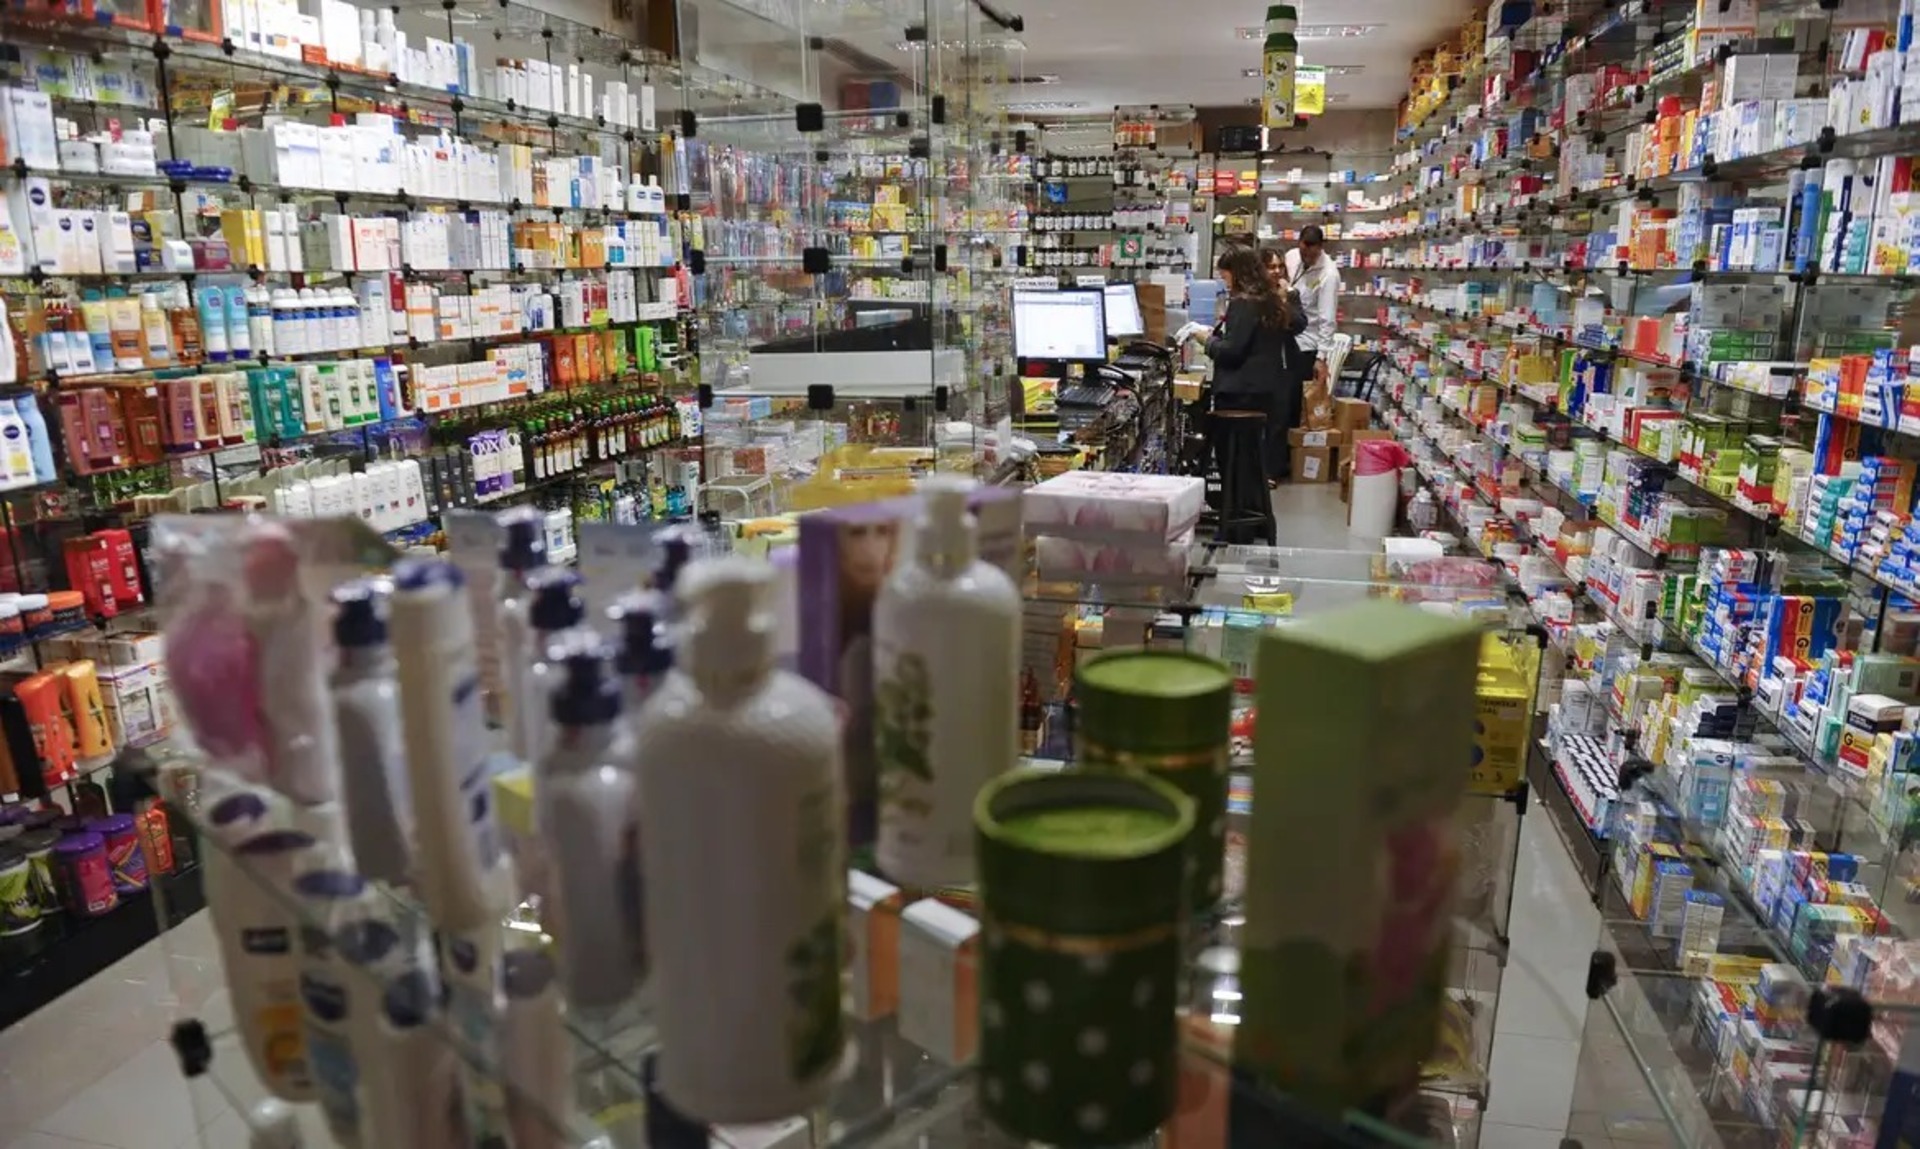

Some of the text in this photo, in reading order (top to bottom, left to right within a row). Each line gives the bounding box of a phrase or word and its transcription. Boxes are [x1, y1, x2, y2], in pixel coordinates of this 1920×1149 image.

[1801, 603, 1813, 614] G
[1797, 637, 1809, 648] G
[1844, 732, 1853, 745] G
